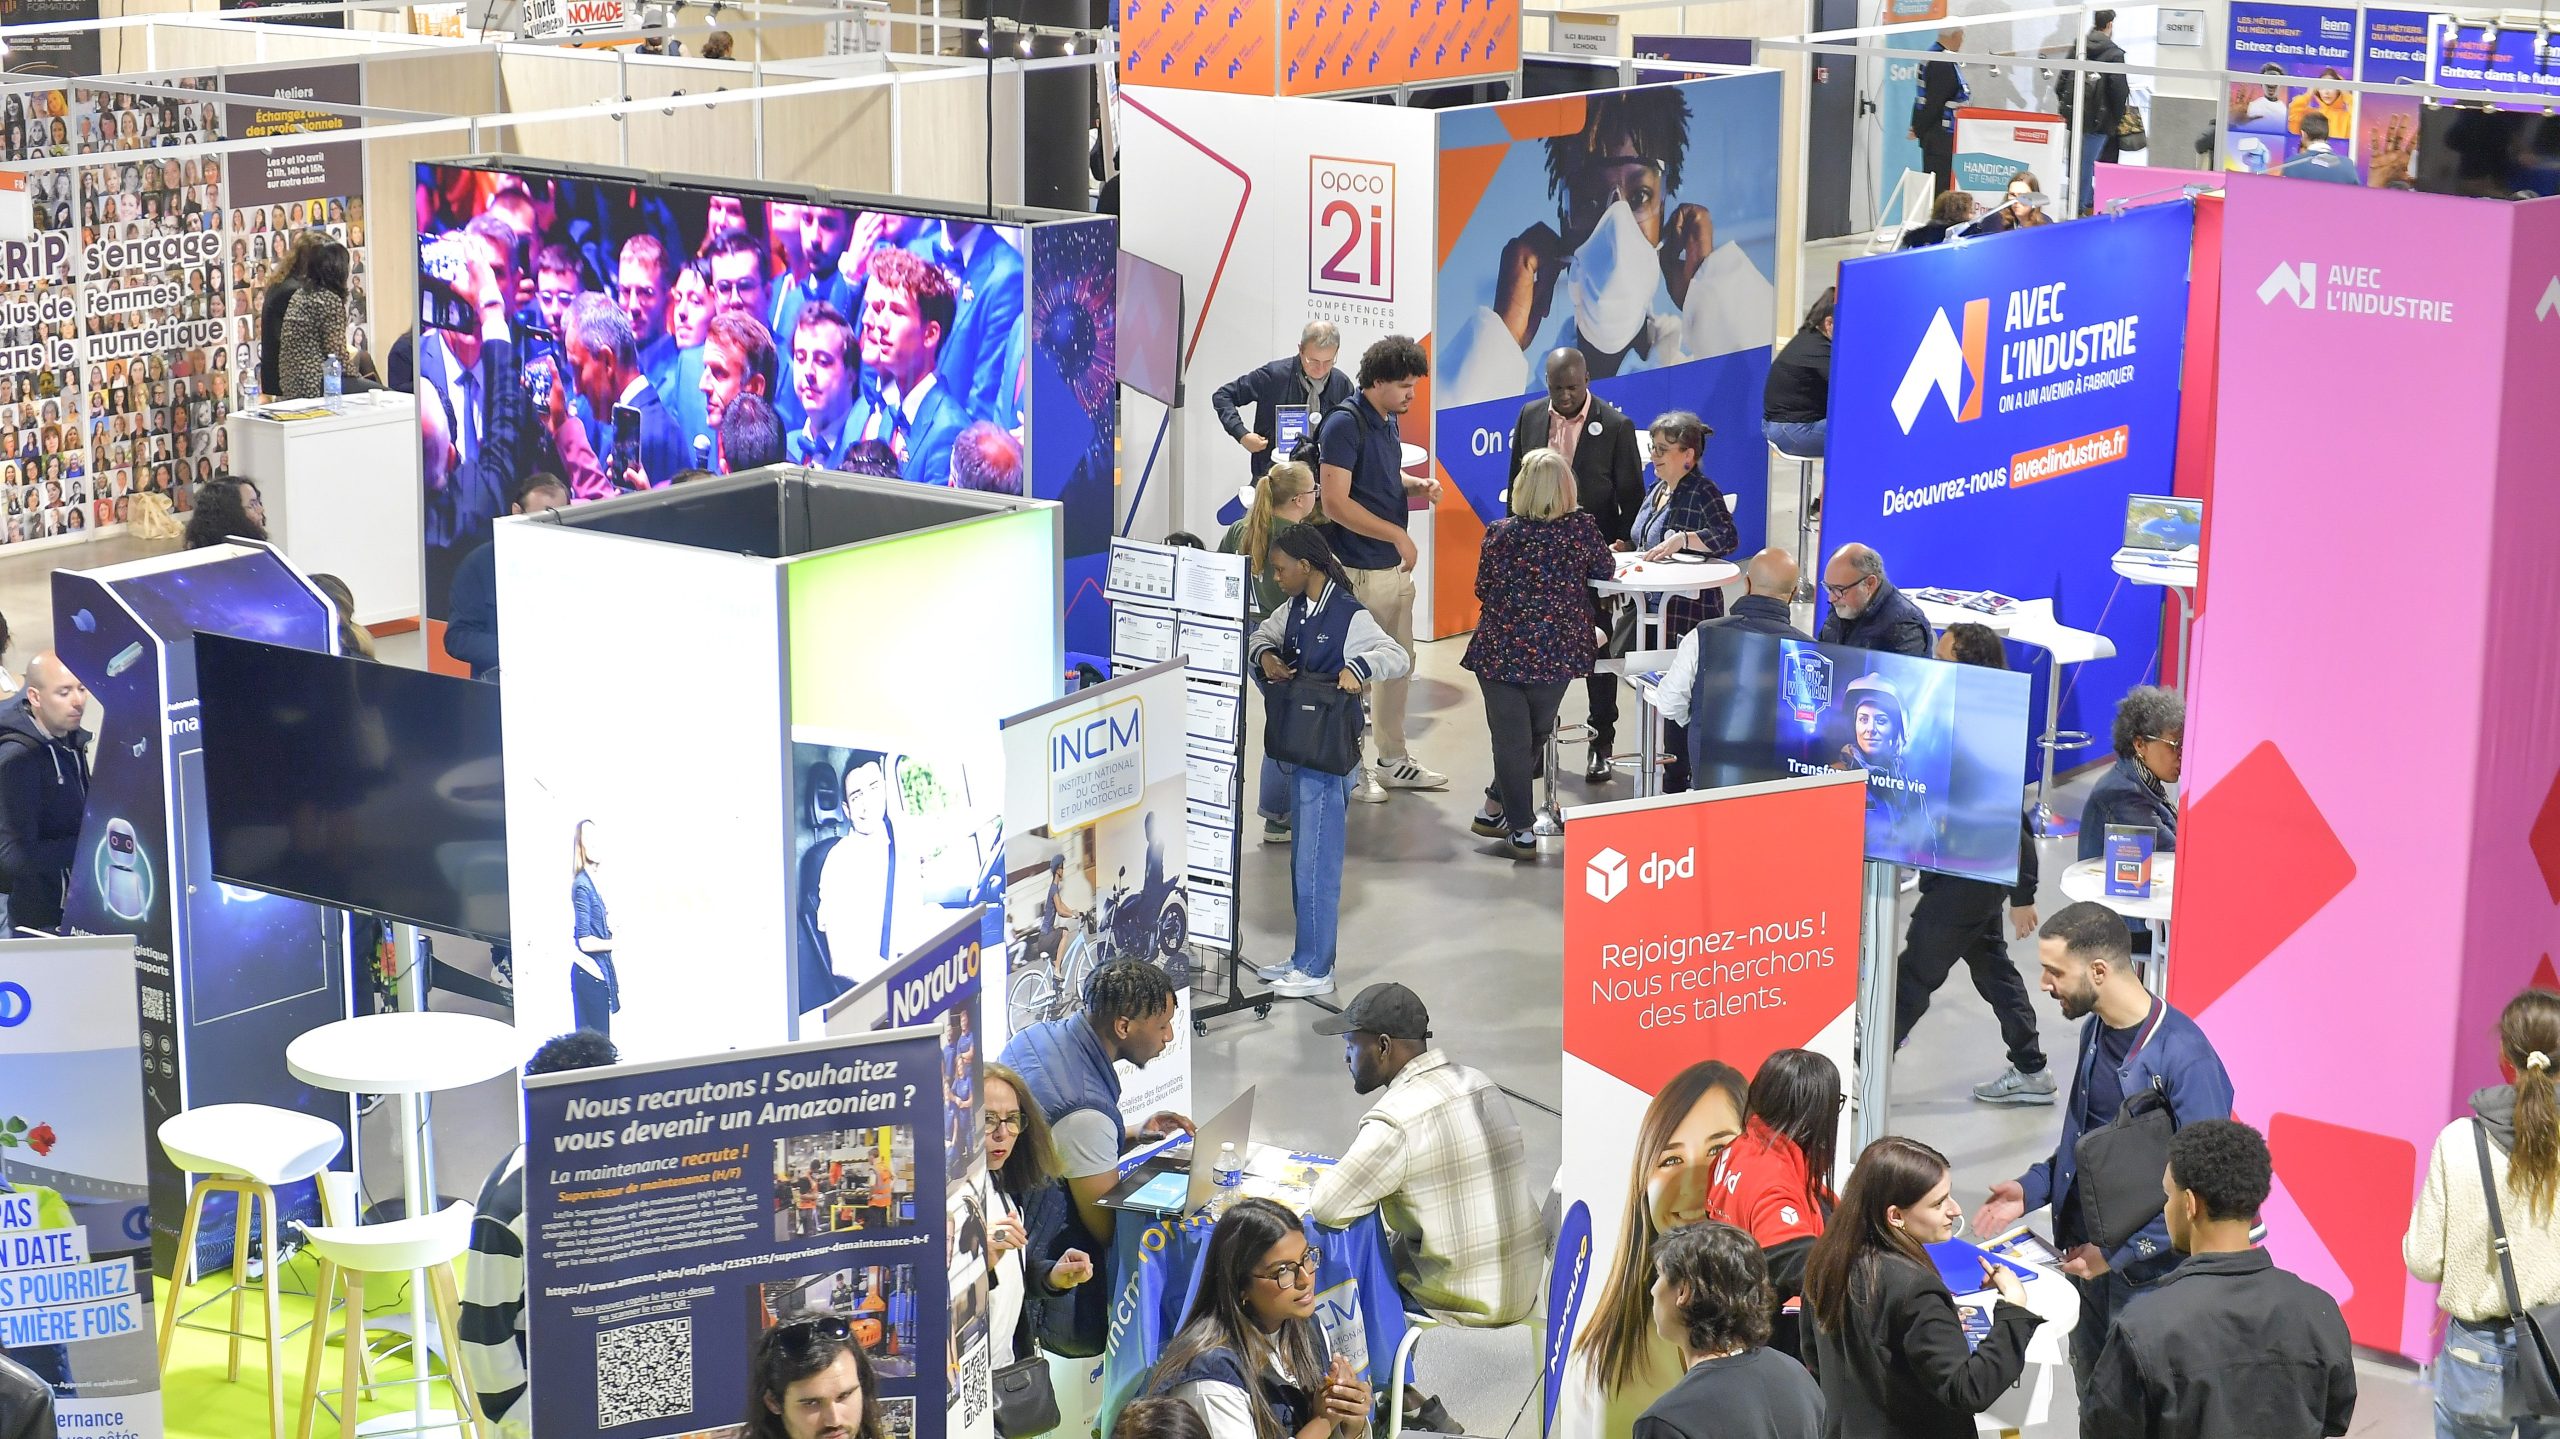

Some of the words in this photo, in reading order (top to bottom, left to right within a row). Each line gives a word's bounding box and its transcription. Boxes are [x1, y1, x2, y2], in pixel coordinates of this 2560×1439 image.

[27, 2, 79, 12] FORMATION
[567, 2, 623, 25] NOMADE
[2166, 23, 2195, 32] SORTIE
[2250, 26, 2301, 37] MÉDICAMENT
[2321, 16, 2351, 32] leem
[1572, 42, 1598, 51] SCHOOL
[1577, 34, 1606, 42] BUSINESS
[2235, 40, 2274, 53] Entrez
[2275, 44, 2303, 55] dans
[2305, 44, 2318, 56] le
[2318, 46, 2349, 58] futur
[2369, 47, 2410, 61] Entrez
[2411, 51, 2427, 62] da
[1890, 63, 1919, 81] Sort
[2441, 65, 2483, 80] Entrez
[2484, 69, 2516, 82] dans
[2517, 70, 2531, 83] le
[273, 87, 314, 99] Ateliers
[255, 109, 306, 123] Échangez
[245, 126, 265, 137] des
[266, 157, 280, 166] Les
[281, 156, 286, 166] 9
[286, 155, 296, 165] et
[296, 154, 305, 164] 10
[306, 152, 325, 163] avril
[1963, 161, 2017, 176] HANDICAP
[266, 167, 274, 177] à
[287, 165, 300, 175] 14h
[301, 165, 311, 174] et
[267, 180, 280, 189] sur
[280, 178, 302, 188] notre
[302, 174, 326, 185] stand
[1321, 171, 1384, 194] opco
[1969, 174, 1979, 183] ET
[1981, 175, 2009, 186] EMPLO
[0, 229, 67, 280] RiP
[1320, 200, 1382, 286] 2i
[2328, 265, 2382, 289] AVEC
[43, 298, 73, 319] de
[1307, 299, 1395, 317] COMPÉTENCES
[2004, 281, 2067, 333] AVEC
[1307, 311, 1394, 330] INDUSTRIES
[0, 346, 43, 371] ans
[51, 340, 74, 363] le
[89, 319, 224, 358] numérique
[1998, 395, 2014, 413] ON
[2015, 393, 2023, 410] A
[2023, 390, 2039, 408] UN
[2039, 380, 2074, 405] AVENIR
[2074, 373, 2082, 395] À
[2082, 365, 2134, 394] FABRIQUER
[1471, 427, 1502, 457] On
[1882, 466, 2007, 517] Découvrez-nous
[2013, 429, 2126, 483] aveclindustrie.fr
[1052, 708, 1139, 773] INCM
[1058, 772, 1092, 793] INSTITUT
[1094, 758, 1135, 781] NATIONAL
[1870, 774, 1905, 791] votre
[1907, 779, 1927, 794] vie
[1076, 786, 1088, 799] DU
[1090, 776, 1116, 793] CYCLE
[1060, 809, 1071, 818] ET
[1071, 803, 1083, 815] DU
[1084, 784, 1134, 810] MOTOCYCLE
[1639, 846, 1695, 890] dpd
[1601, 916, 1815, 971] Rejoignez-nous
[1821, 911, 1827, 935] !
[134, 944, 169, 962] gistique
[134, 960, 170, 977] ansports
[1591, 975, 1662, 1005] Nous
[1670, 947, 1835, 992] recherchons
[893, 941, 980, 1028] Norauto
[1638, 1003, 1686, 1030] des
[1693, 987, 1787, 1020] talents.
[565, 1094, 631, 1123] Nous
[636, 1079, 757, 1114] recrutons
[760, 1071, 770, 1095] !
[775, 1060, 899, 1093] Souhaitez
[1118, 1094, 1143, 1109] écialiste
[1144, 1090, 1155, 1099] des
[1156, 1075, 1184, 1093] formations
[1121, 1101, 1146, 1115] métiers
[1147, 1098, 1154, 1106] du
[1155, 1091, 1168, 1102] deux
[1169, 1083, 1184, 1095] roues
[553, 1126, 615, 1154] vous
[620, 1113, 715, 1145] devenir
[719, 1109, 752, 1132] un
[757, 1091, 898, 1126] Amazonien
[902, 1085, 917, 1109] ?
[550, 1169, 571, 1185] La
[574, 1156, 679, 1183] maintenance
[681, 1146, 739, 1169] recrute
[742, 1143, 750, 1159] !
[558, 1186, 624, 1203] Superviseur
[625, 1183, 639, 1194] de
[639, 1172, 711, 1192] maintenance
[712, 1166, 742, 1182] (H/F)
[16, 1232, 81, 1267] DATE,
[0, 1277, 13, 1307] S
[20, 1263, 129, 1305] POURRIEZ
[571, 1306, 595, 1315] Vous
[595, 1301, 625, 1313] pouvez
[625, 1296, 651, 1309] copier
[651, 1293, 660, 1301] le
[660, 1291, 678, 1300] lien
[678, 1286, 716, 1297] ci-dessus
[598, 1314, 610, 1323] ou
[610, 1308, 641, 1320] scanner
[641, 1305, 651, 1314] le
[651, 1302, 672, 1312] code
[673, 1299, 688, 1309] QR
[1550, 1235, 1588, 1375] Norauto
[0, 1307, 78, 1346] EMIÈRE
[83, 1302, 137, 1337] FOIS.
[59, 1381, 92, 1390] Apprenti
[56, 1411, 124, 1428] ernance
